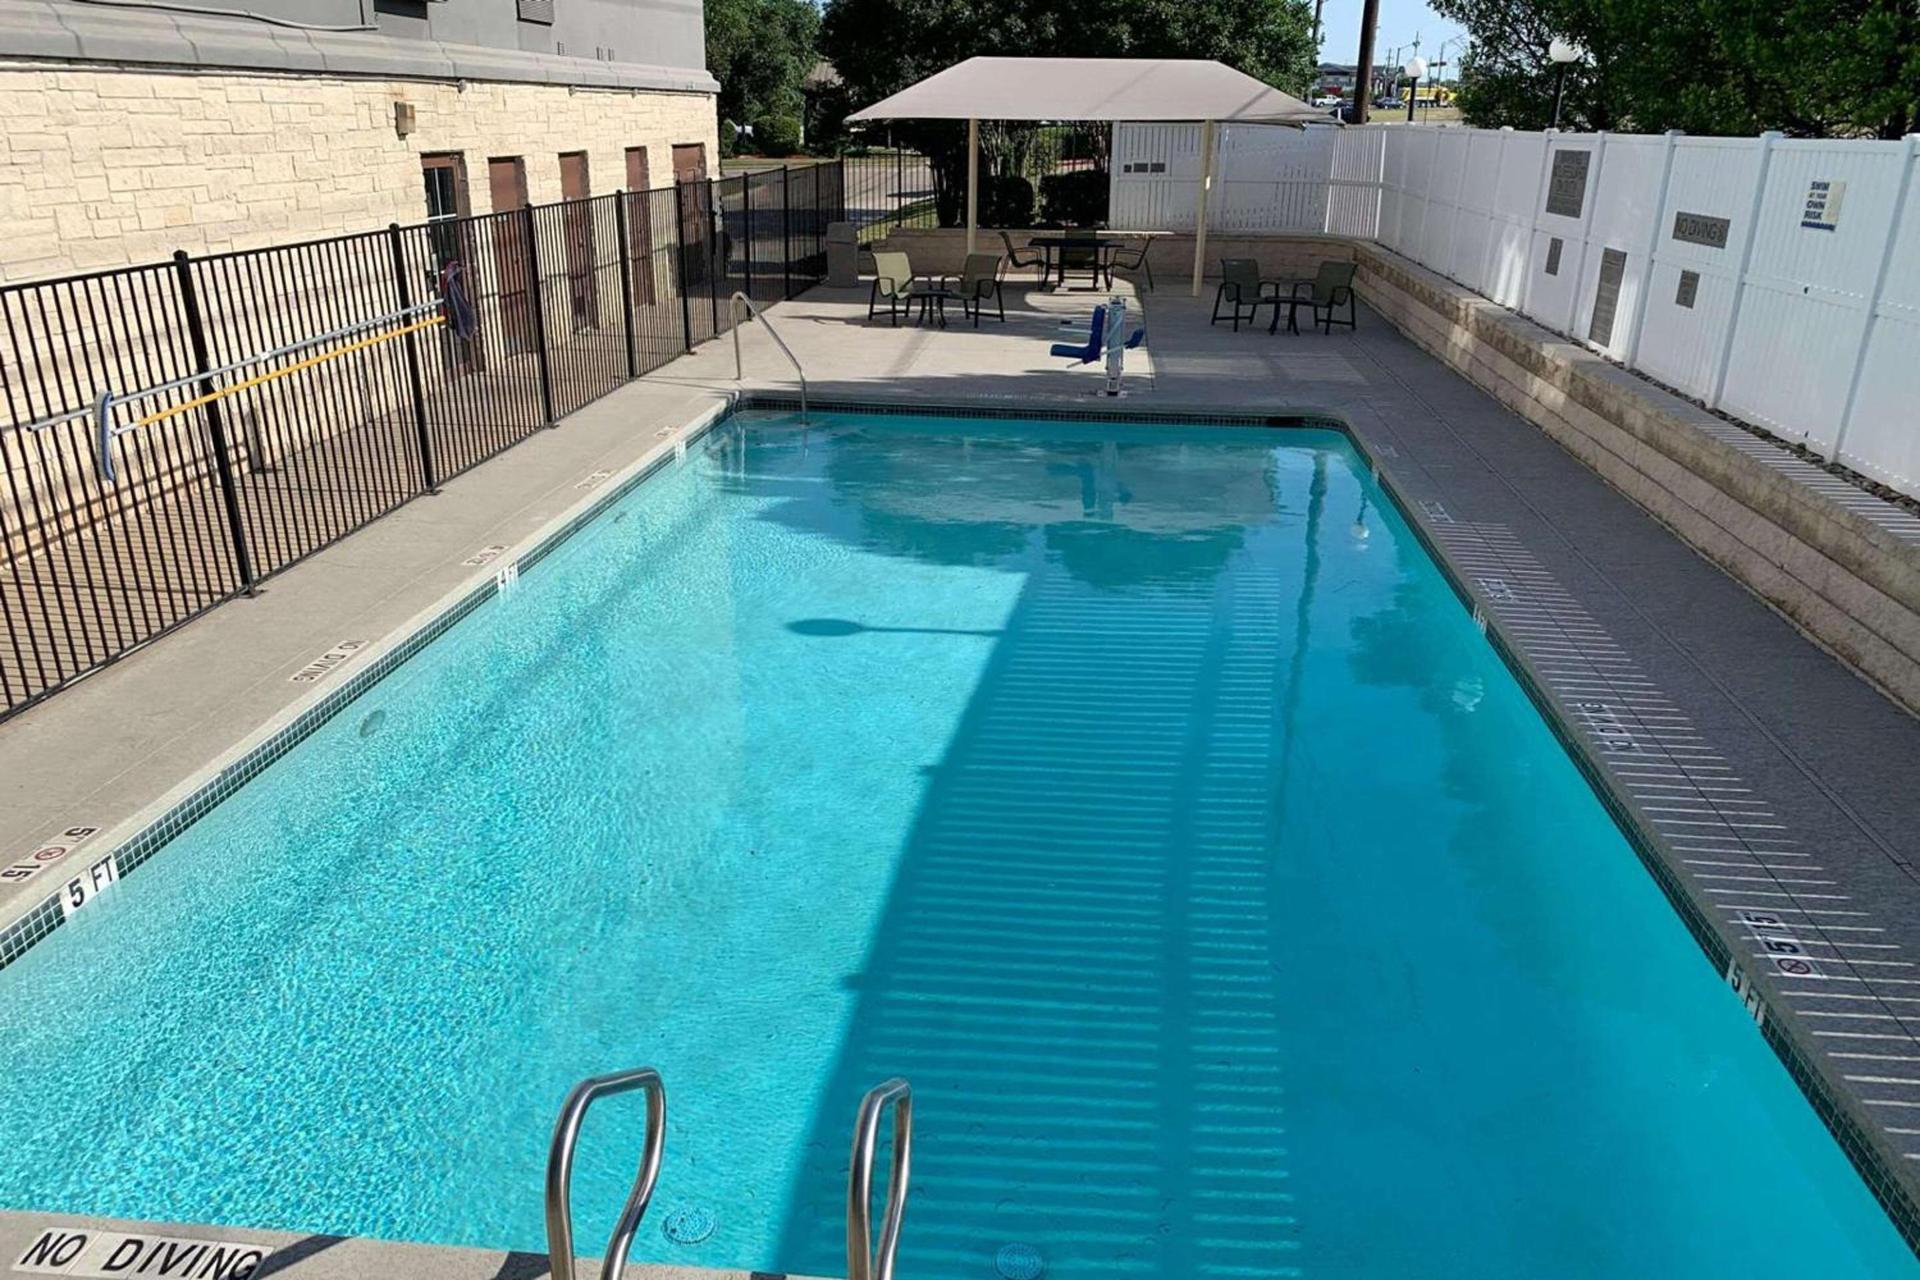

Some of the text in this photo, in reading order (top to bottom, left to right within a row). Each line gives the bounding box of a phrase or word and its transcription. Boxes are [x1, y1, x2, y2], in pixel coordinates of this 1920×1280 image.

[1804, 210, 1823, 220] RISK
[68, 855, 113, 908] 5 FT
[19, 1232, 264, 1280] NO DIVING
